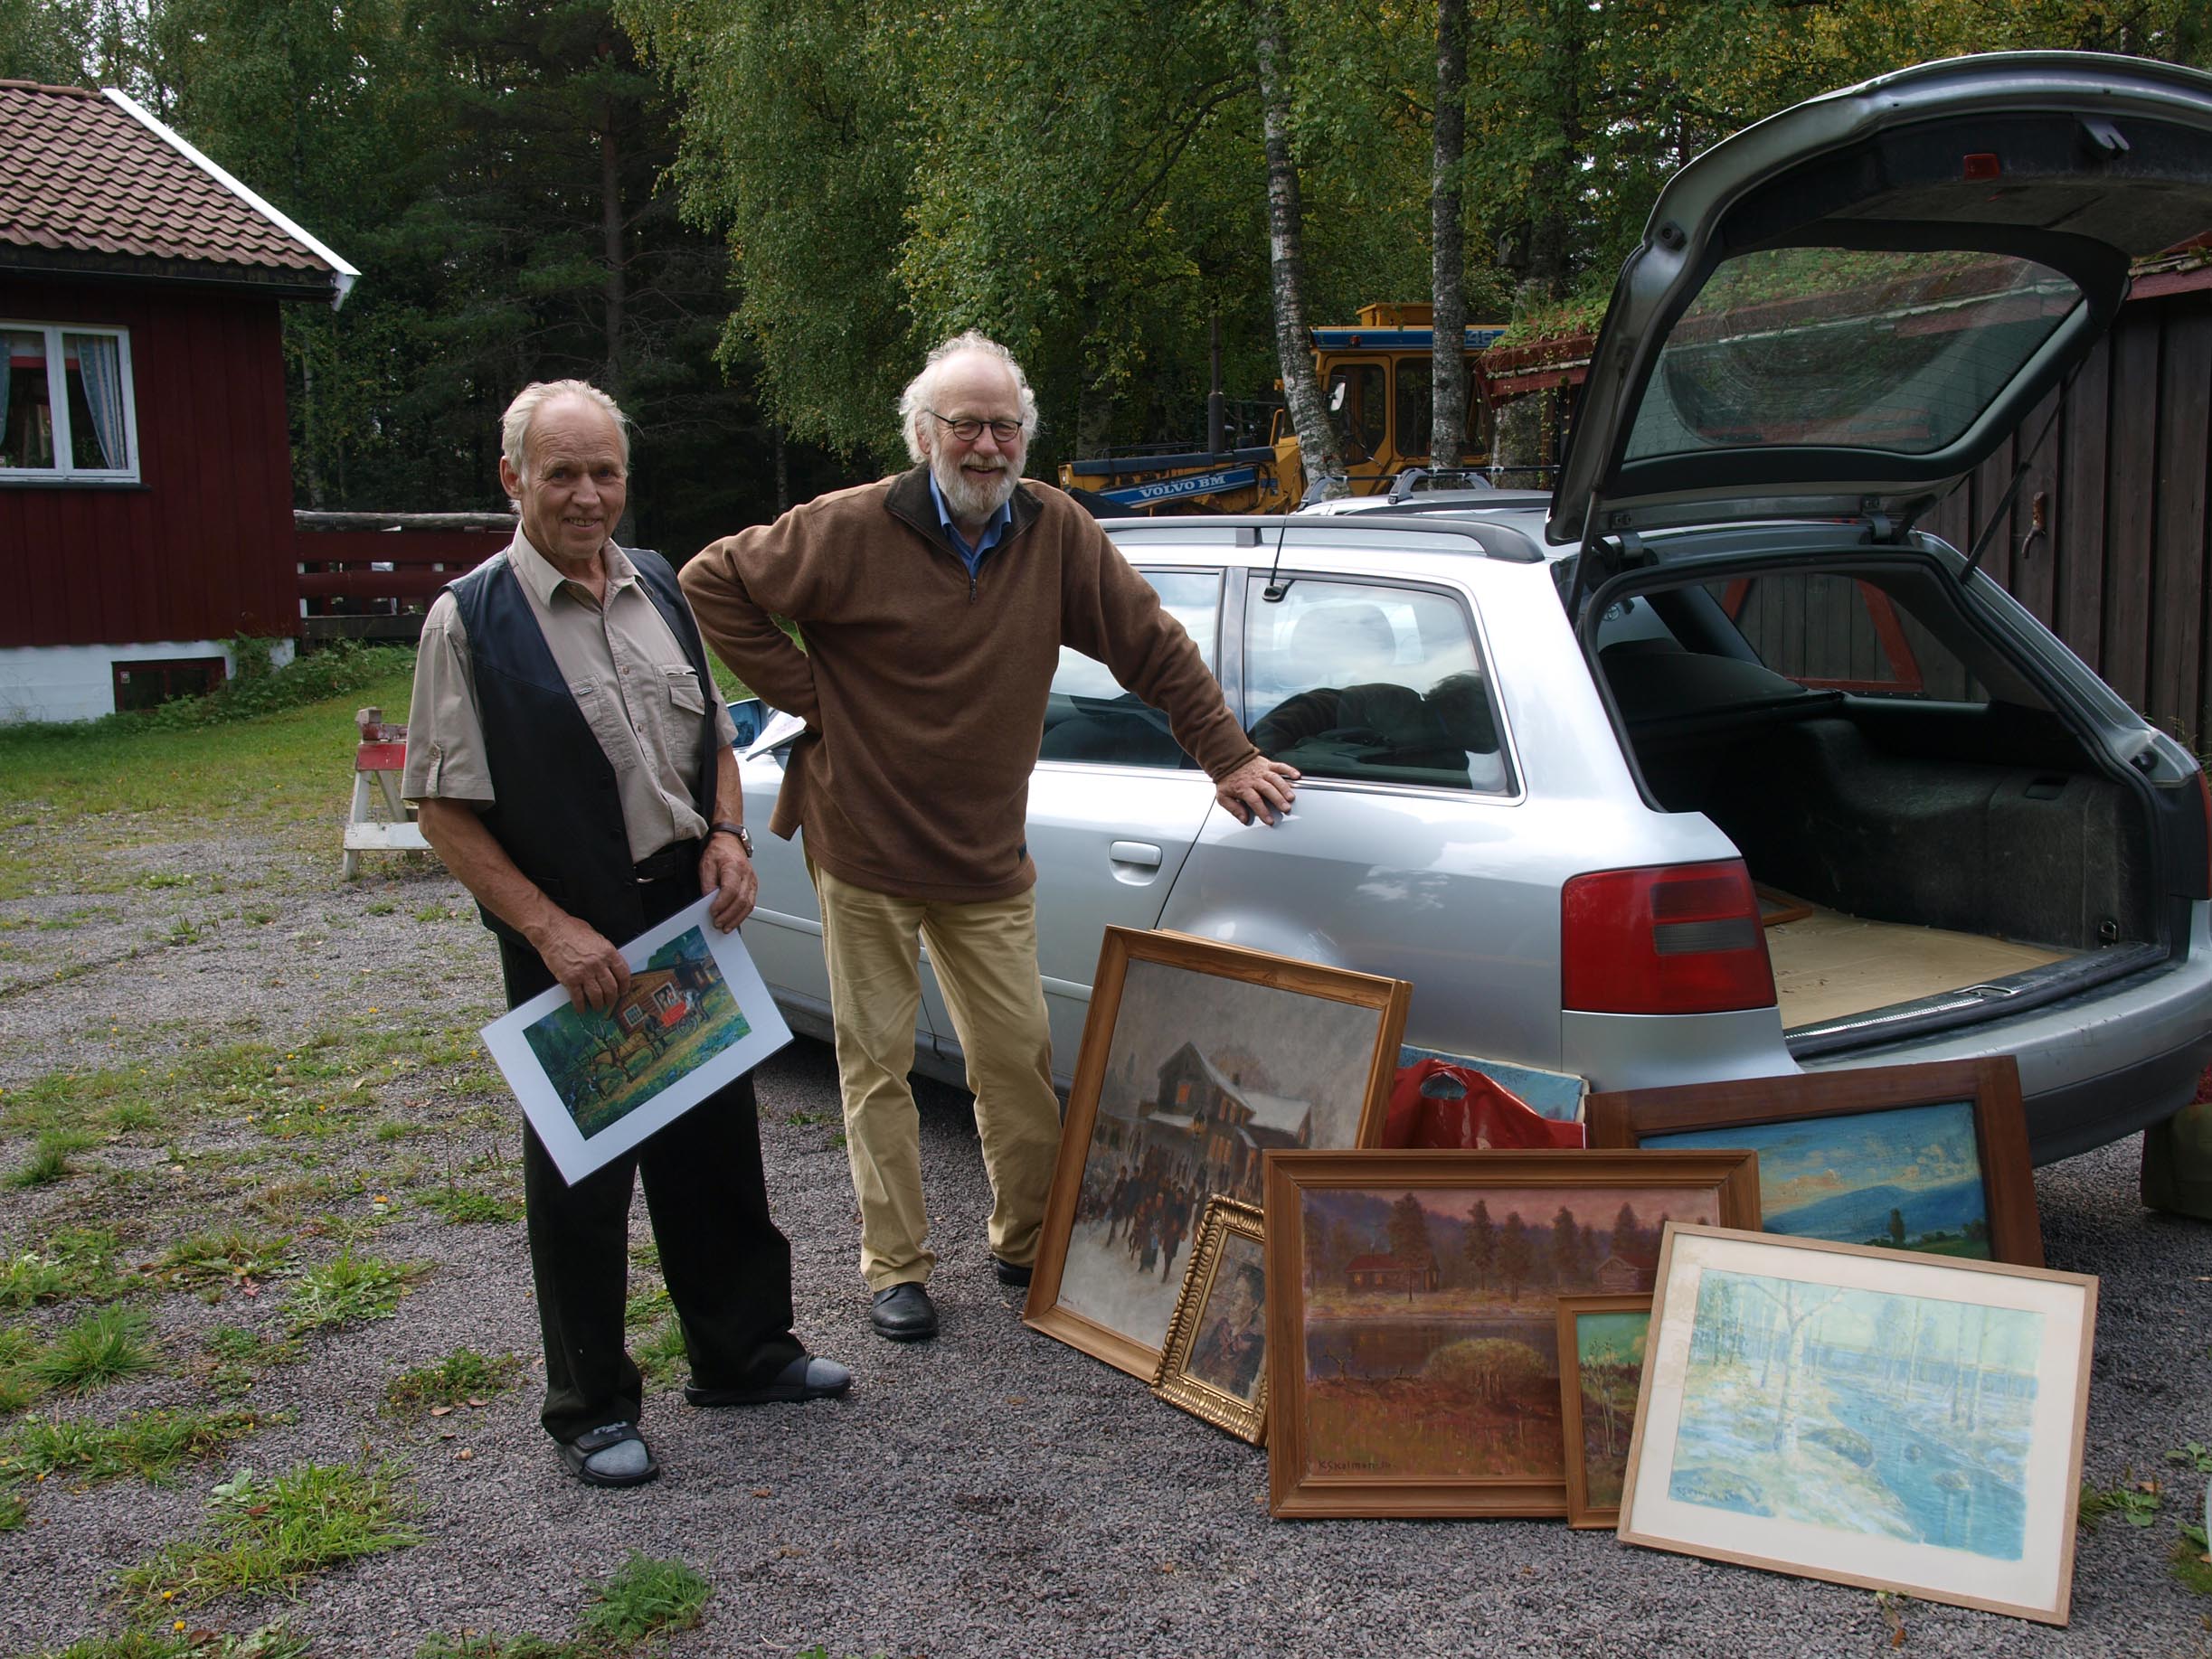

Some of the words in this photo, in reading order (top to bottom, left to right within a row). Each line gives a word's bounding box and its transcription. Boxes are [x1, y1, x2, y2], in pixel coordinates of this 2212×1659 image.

[1463, 331, 1494, 344] 46
[1139, 481, 1196, 498] VOLVO
[1198, 475, 1226, 488] BM
